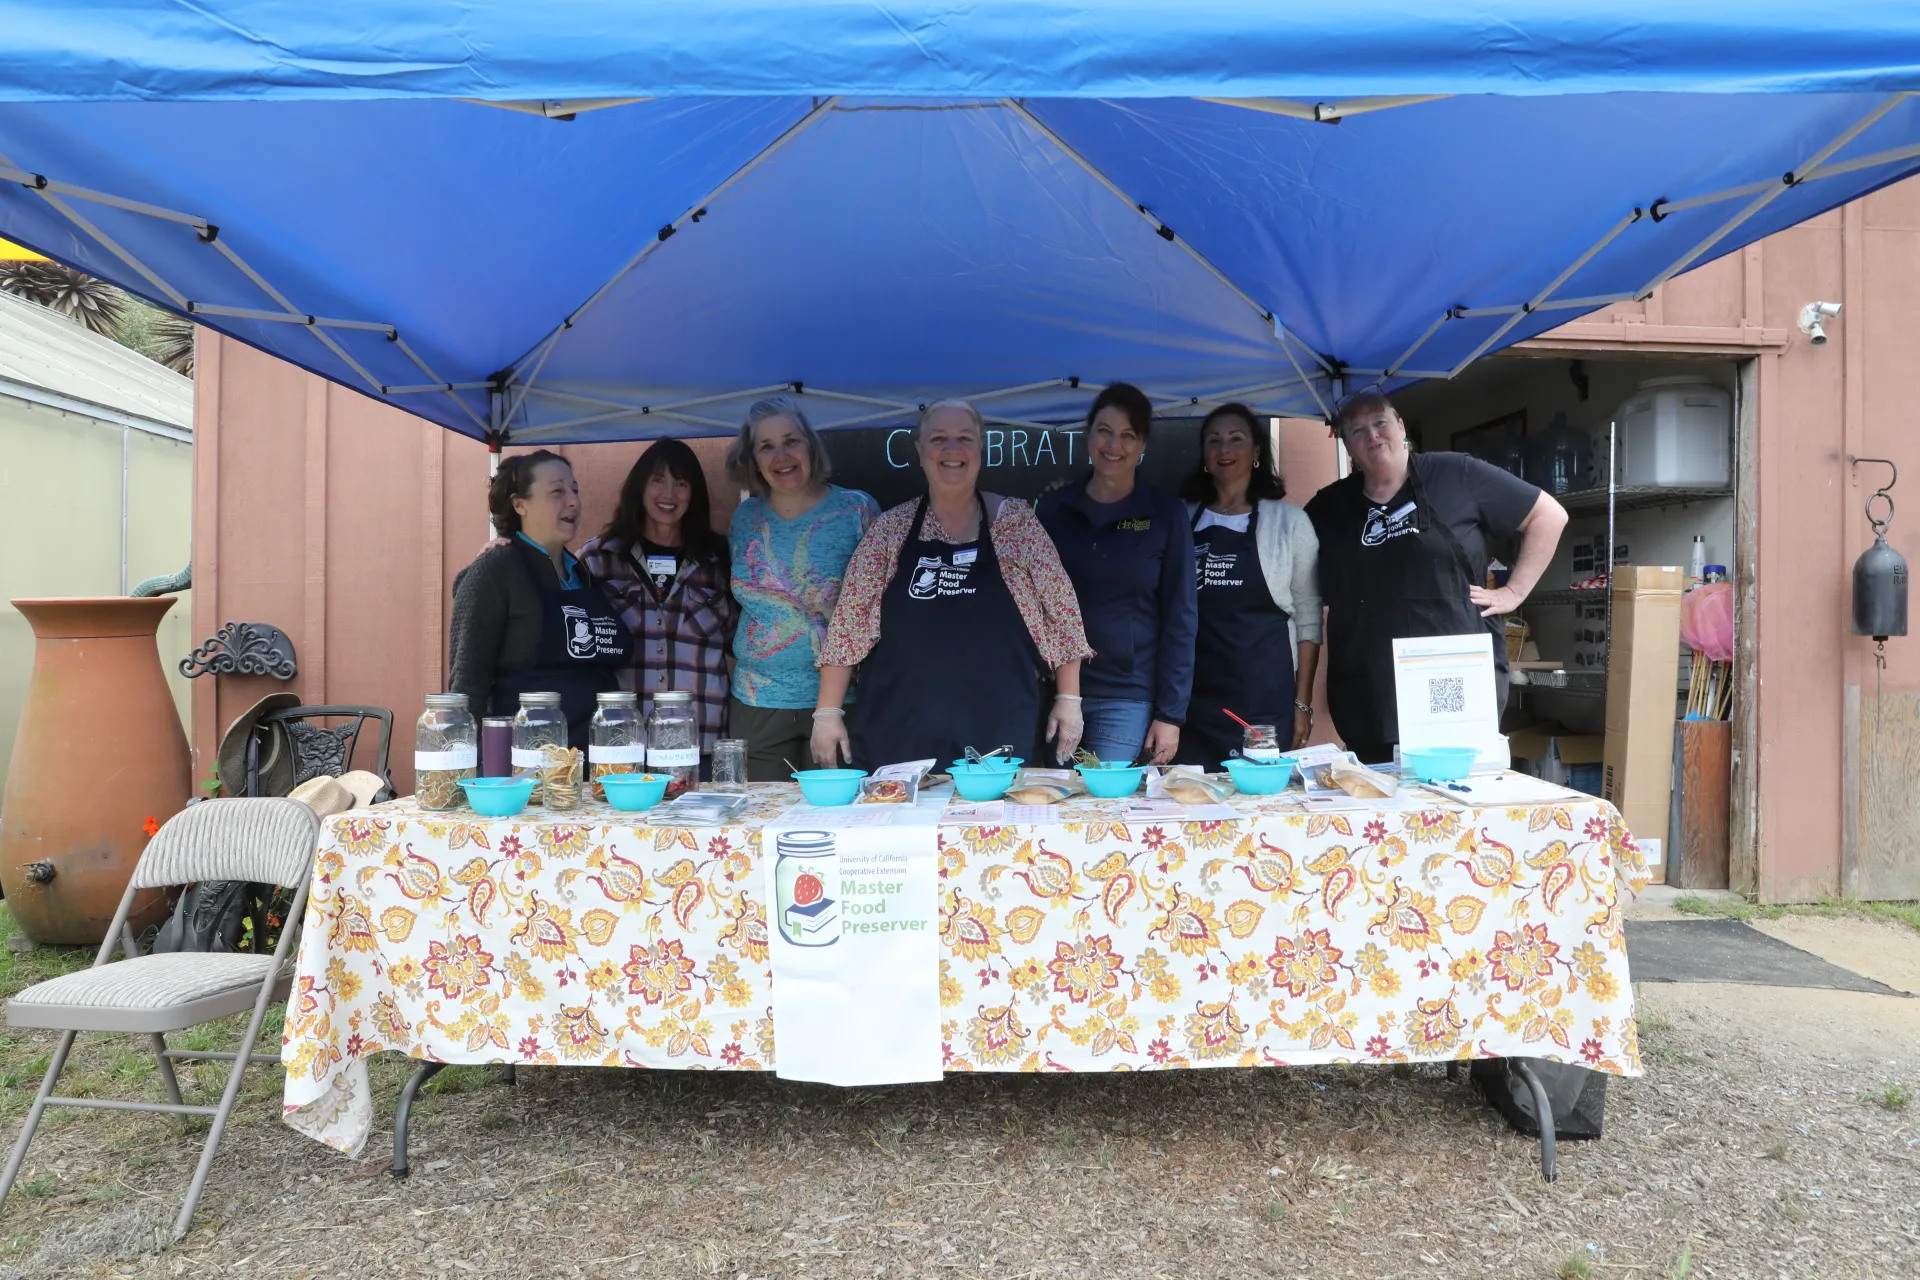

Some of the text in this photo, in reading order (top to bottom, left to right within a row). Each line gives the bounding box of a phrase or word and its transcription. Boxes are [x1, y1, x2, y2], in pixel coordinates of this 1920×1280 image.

[939, 571, 968, 580] Master
[1204, 569, 1226, 577] Food
[938, 579, 960, 588] Food
[1204, 577, 1244, 586] Preserver
[937, 588, 977, 596] Preserver
[594, 626, 618, 636] Master
[595, 636, 613, 645] Food
[839, 855, 870, 864] University
[878, 854, 908, 863] California
[839, 867, 907, 876] Cooperative Extension
[840, 880, 904, 895] Master
[841, 898, 886, 915] Food
[842, 919, 928, 935] Preserver
